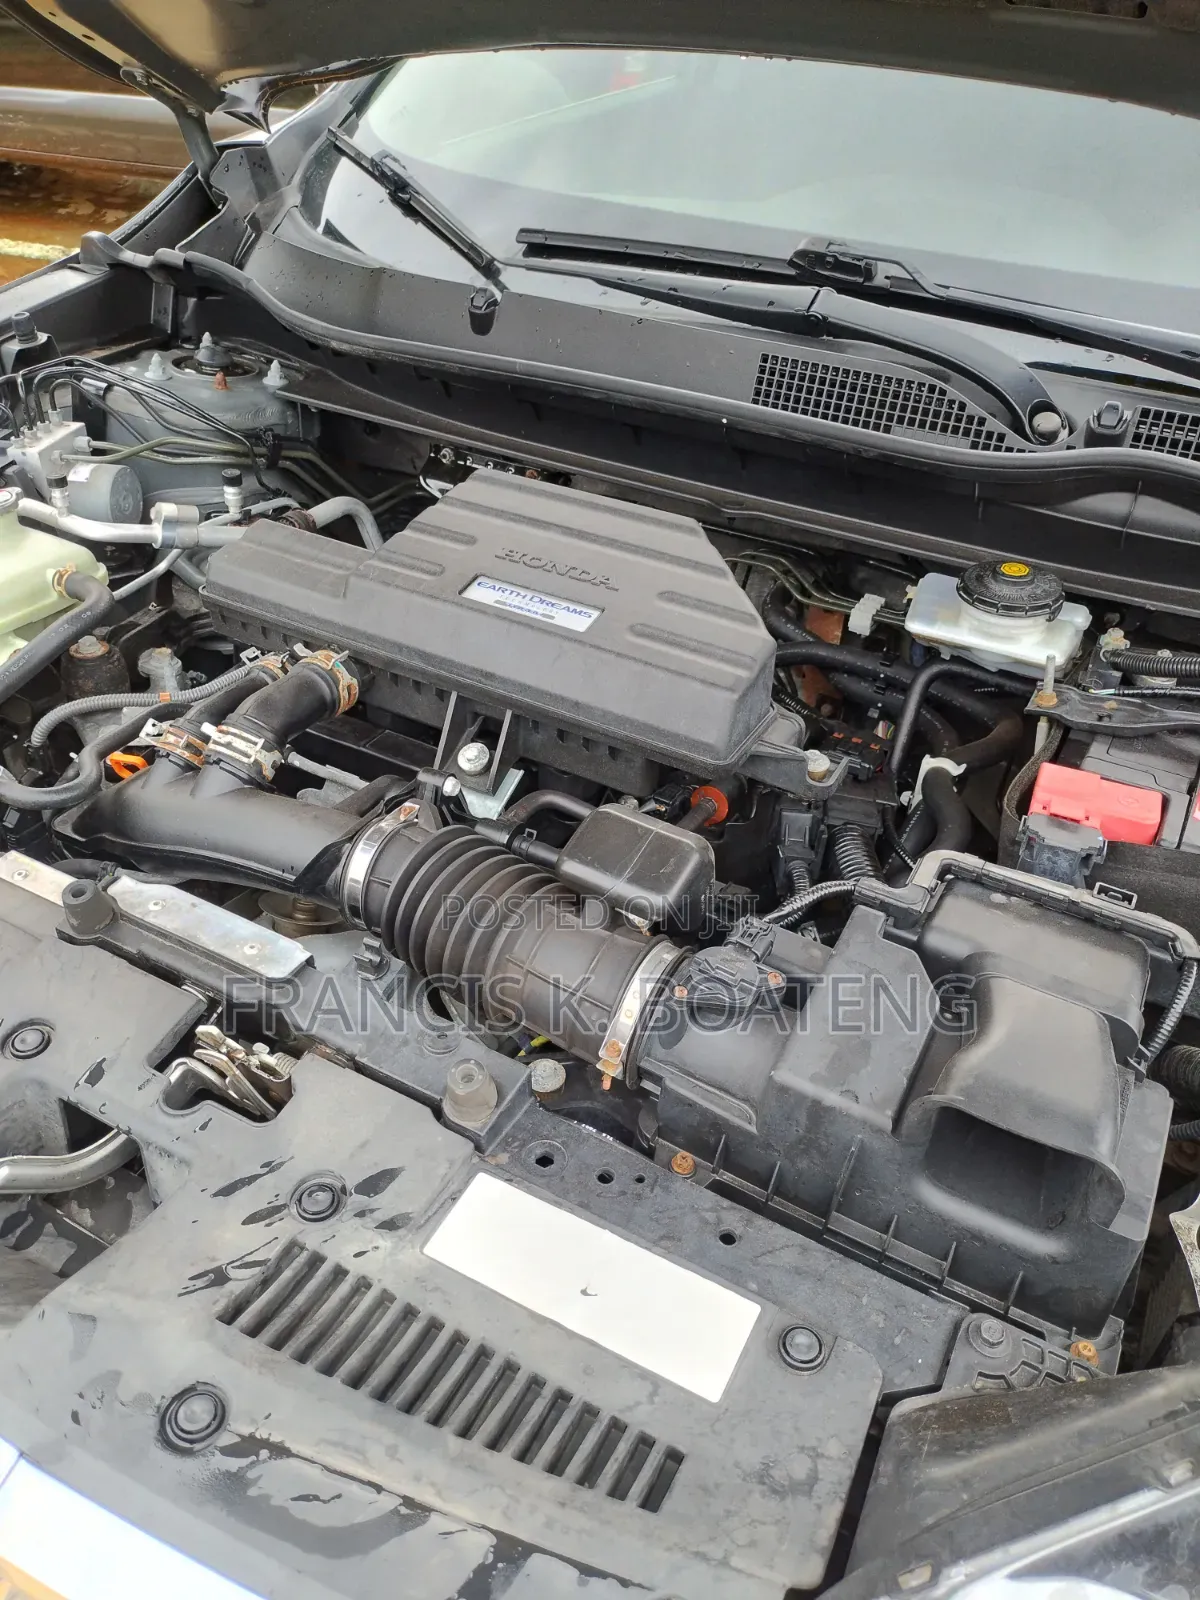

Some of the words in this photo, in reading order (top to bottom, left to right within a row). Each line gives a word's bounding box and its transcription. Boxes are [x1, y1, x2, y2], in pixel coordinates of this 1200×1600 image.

[494, 547, 620, 592] HONDA
[476, 580, 527, 600] EARTH
[529, 595, 594, 619] DREAMS
